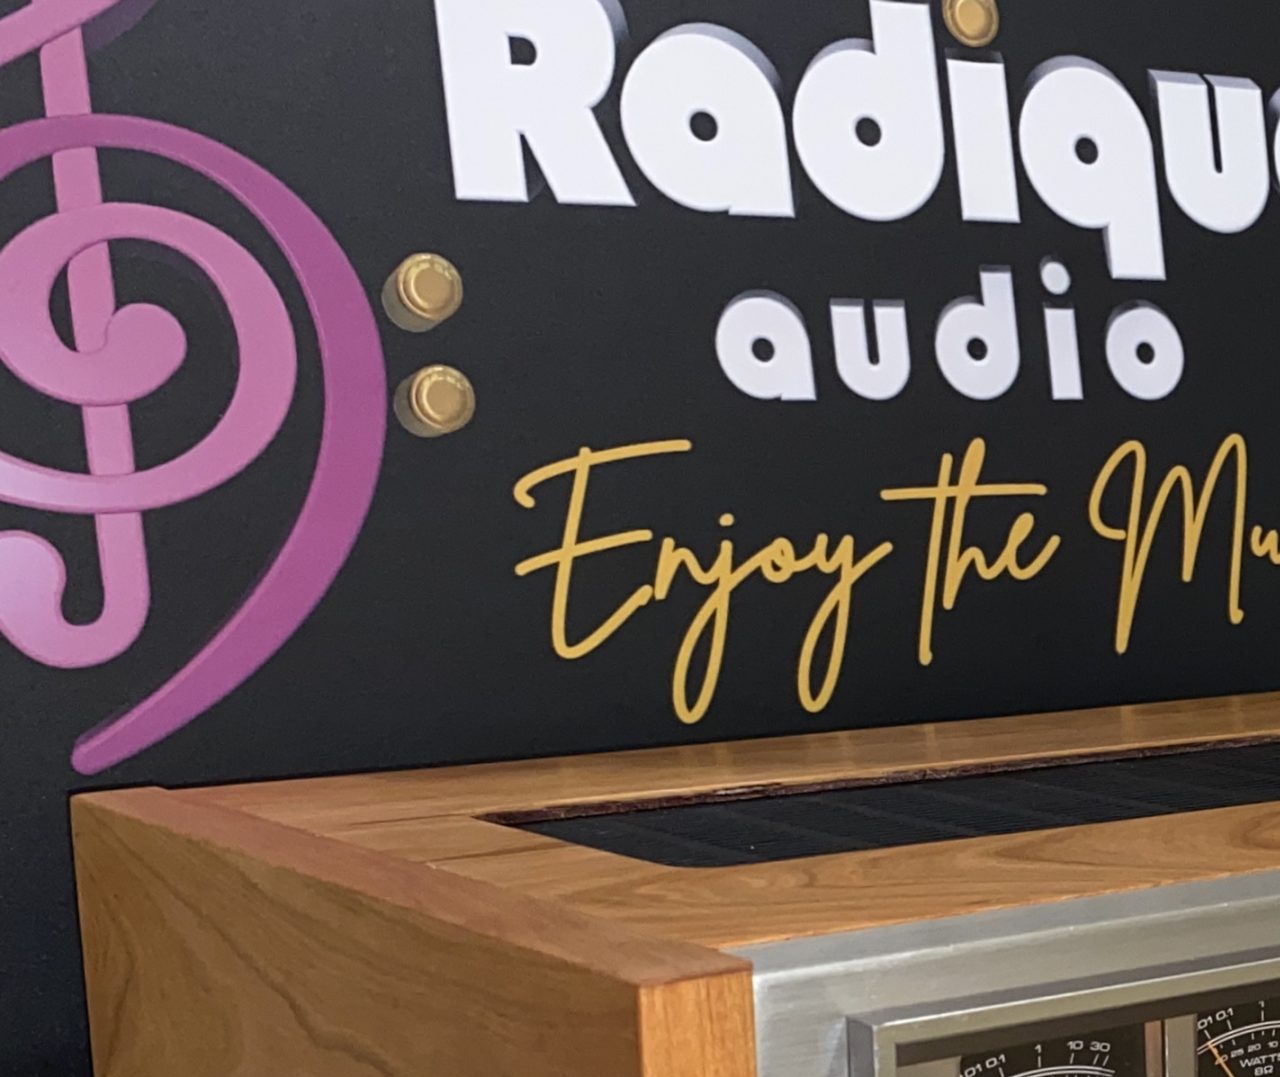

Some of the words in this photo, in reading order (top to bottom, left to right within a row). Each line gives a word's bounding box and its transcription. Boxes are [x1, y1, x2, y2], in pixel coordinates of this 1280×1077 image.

[714, 255, 1184, 401] audio
[513, 439, 893, 723] Enjoy
[880, 437, 1061, 665] the
[1067, 1040, 1084, 1050] 10
[1089, 1041, 1111, 1052] 30
